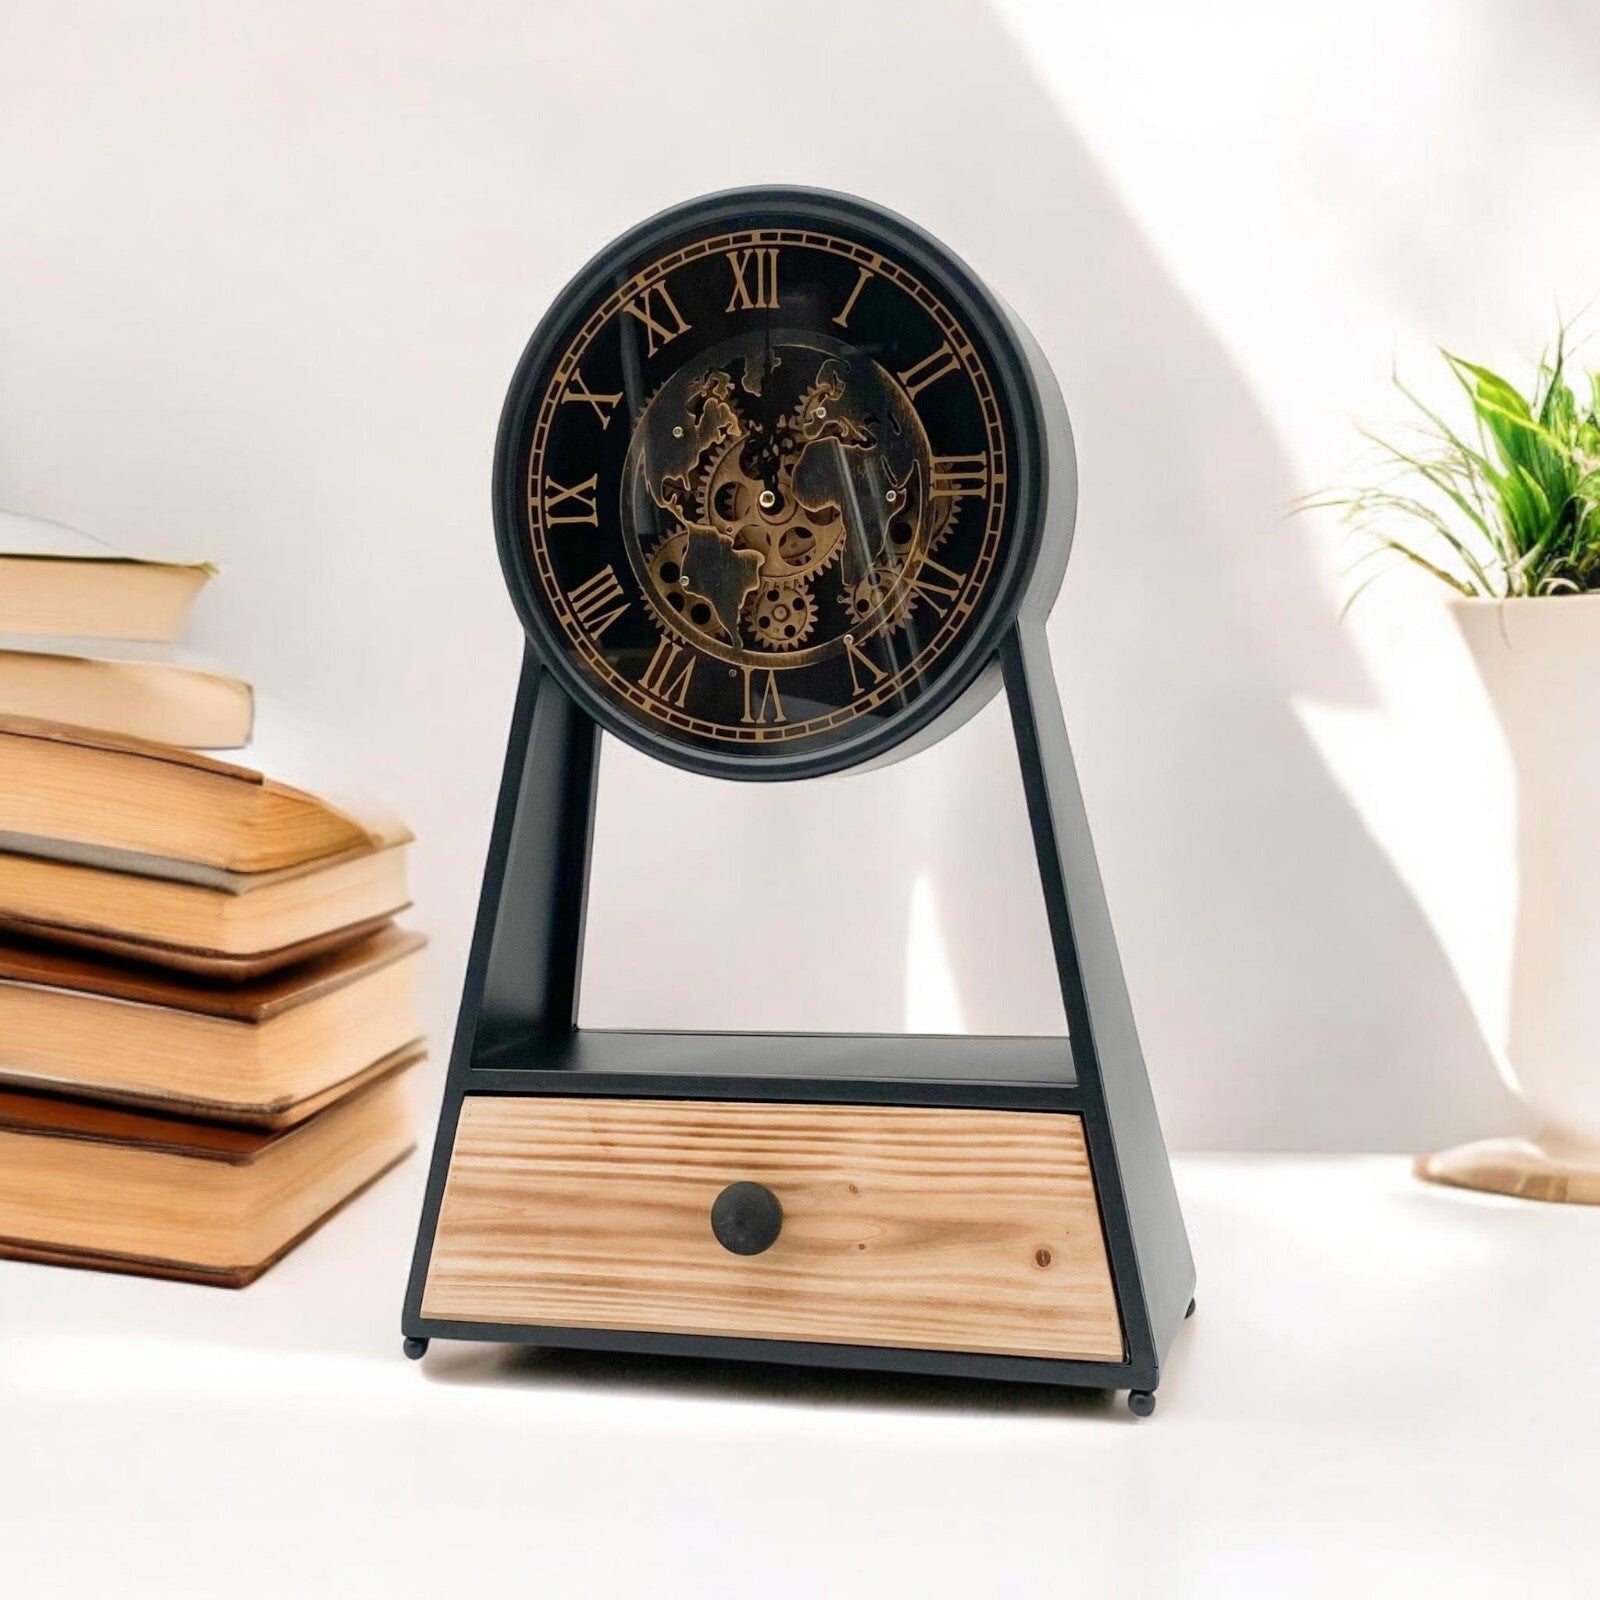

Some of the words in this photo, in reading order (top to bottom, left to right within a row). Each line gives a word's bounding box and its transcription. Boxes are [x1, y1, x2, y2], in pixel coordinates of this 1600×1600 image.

[726, 249, 780, 313] XII
[832, 266, 874, 328] I
[623, 280, 692, 358] XI
[561, 368, 623, 430] X
[896, 340, 961, 400] II
[545, 473, 598, 529] IX
[928, 451, 988, 499] III
[567, 564, 631, 641] VIII
[637, 634, 697, 708] VII
[740, 664, 787, 723] VI
[846, 638, 888, 696] V
